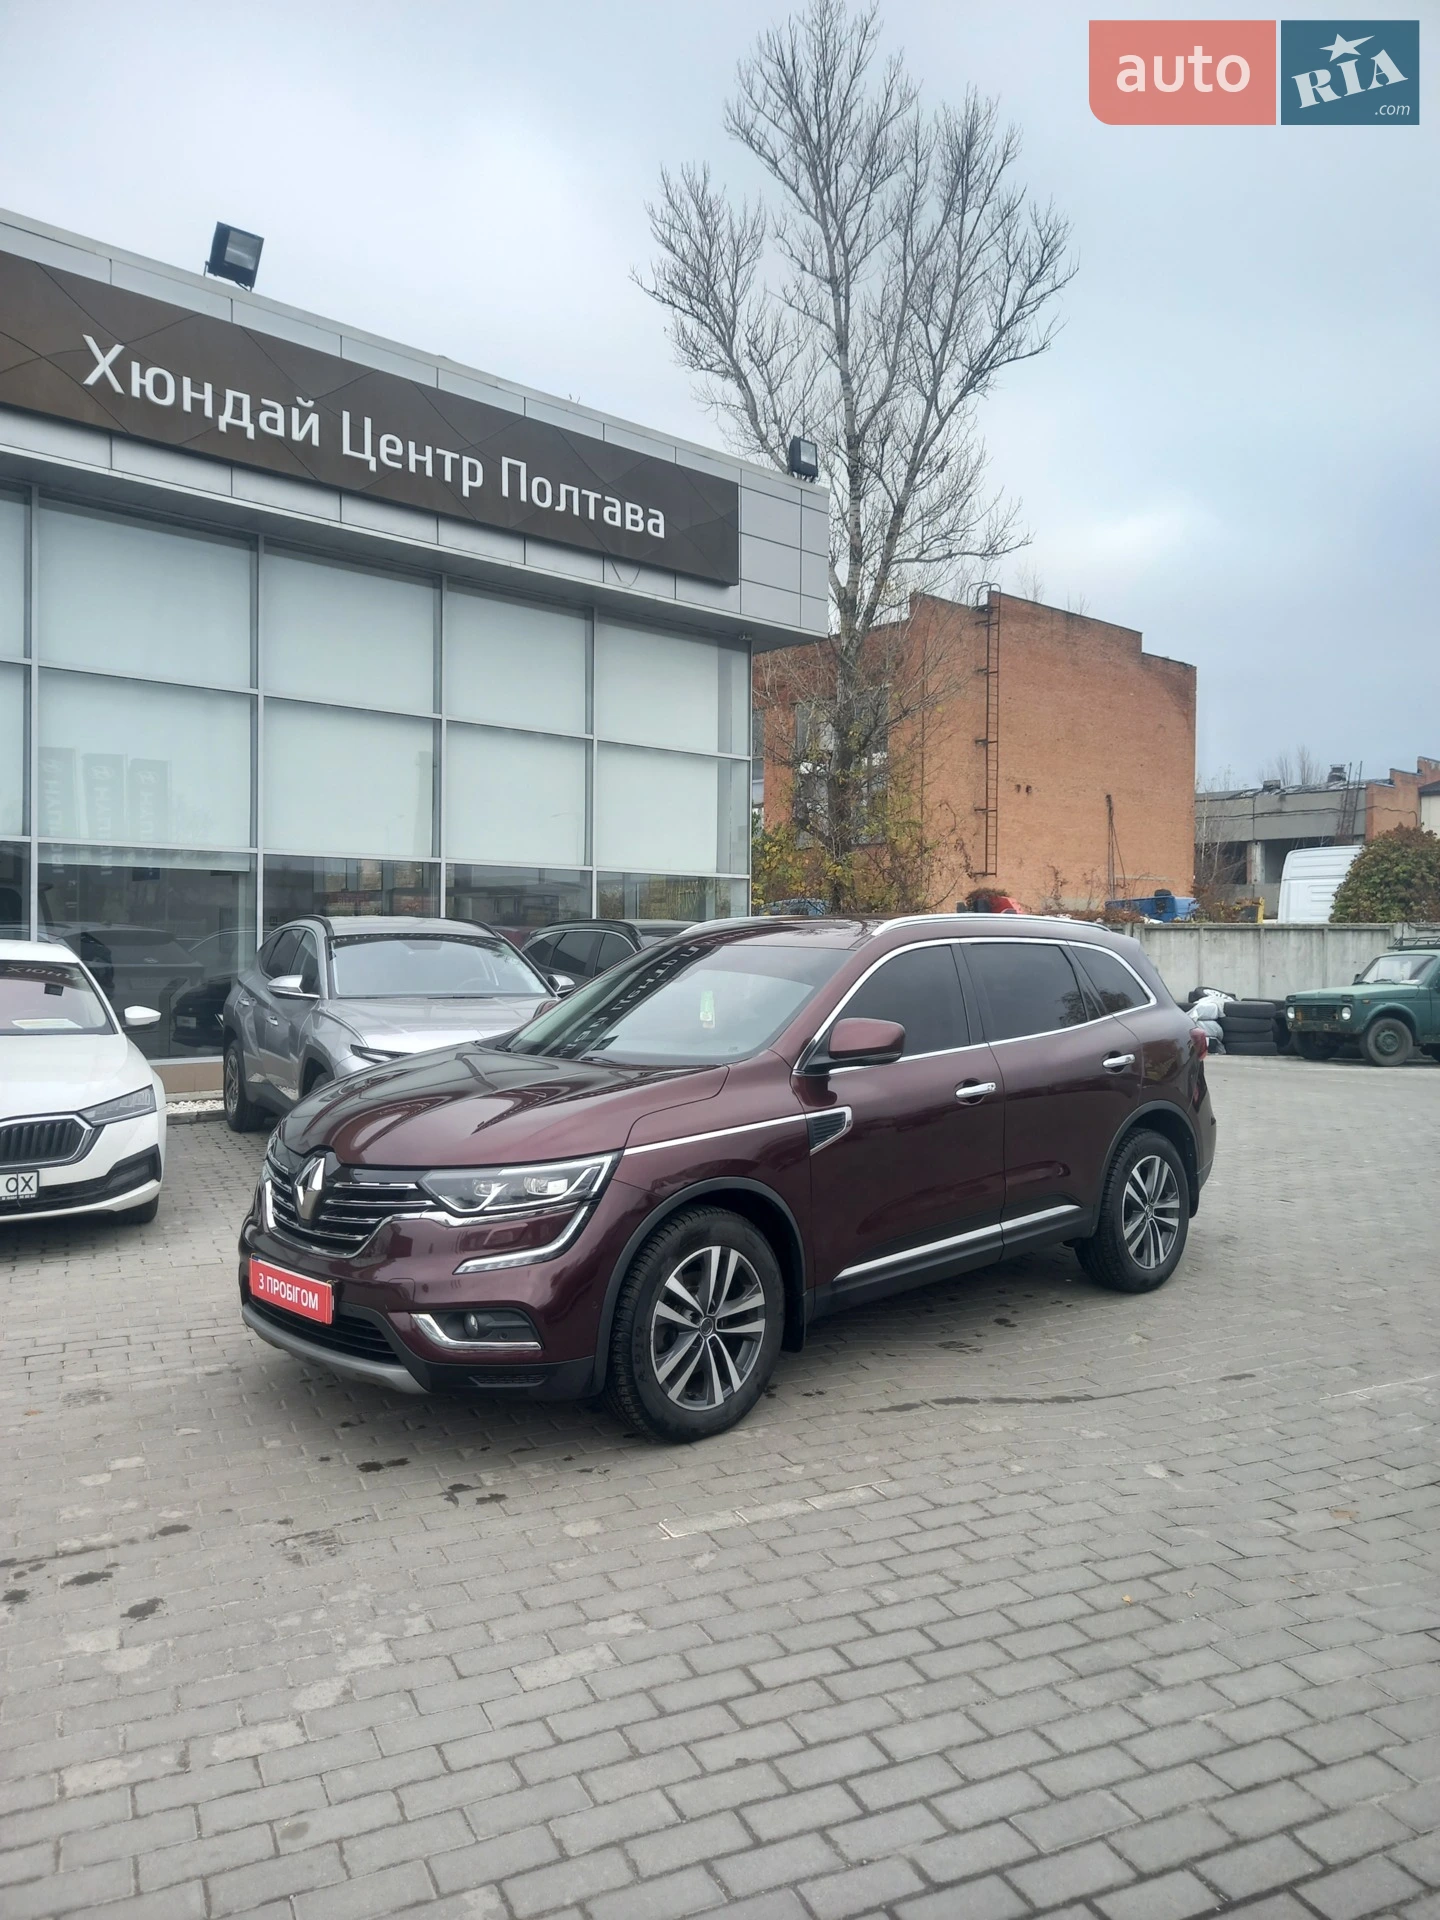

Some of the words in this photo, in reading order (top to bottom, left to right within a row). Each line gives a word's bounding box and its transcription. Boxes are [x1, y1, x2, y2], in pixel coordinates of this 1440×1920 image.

[81, 333, 321, 447] Хюндай
[341, 410, 485, 498] Центр
[500, 455, 668, 540] Полтава
[266, 1275, 319, 1311] ПРОБІГОМ
